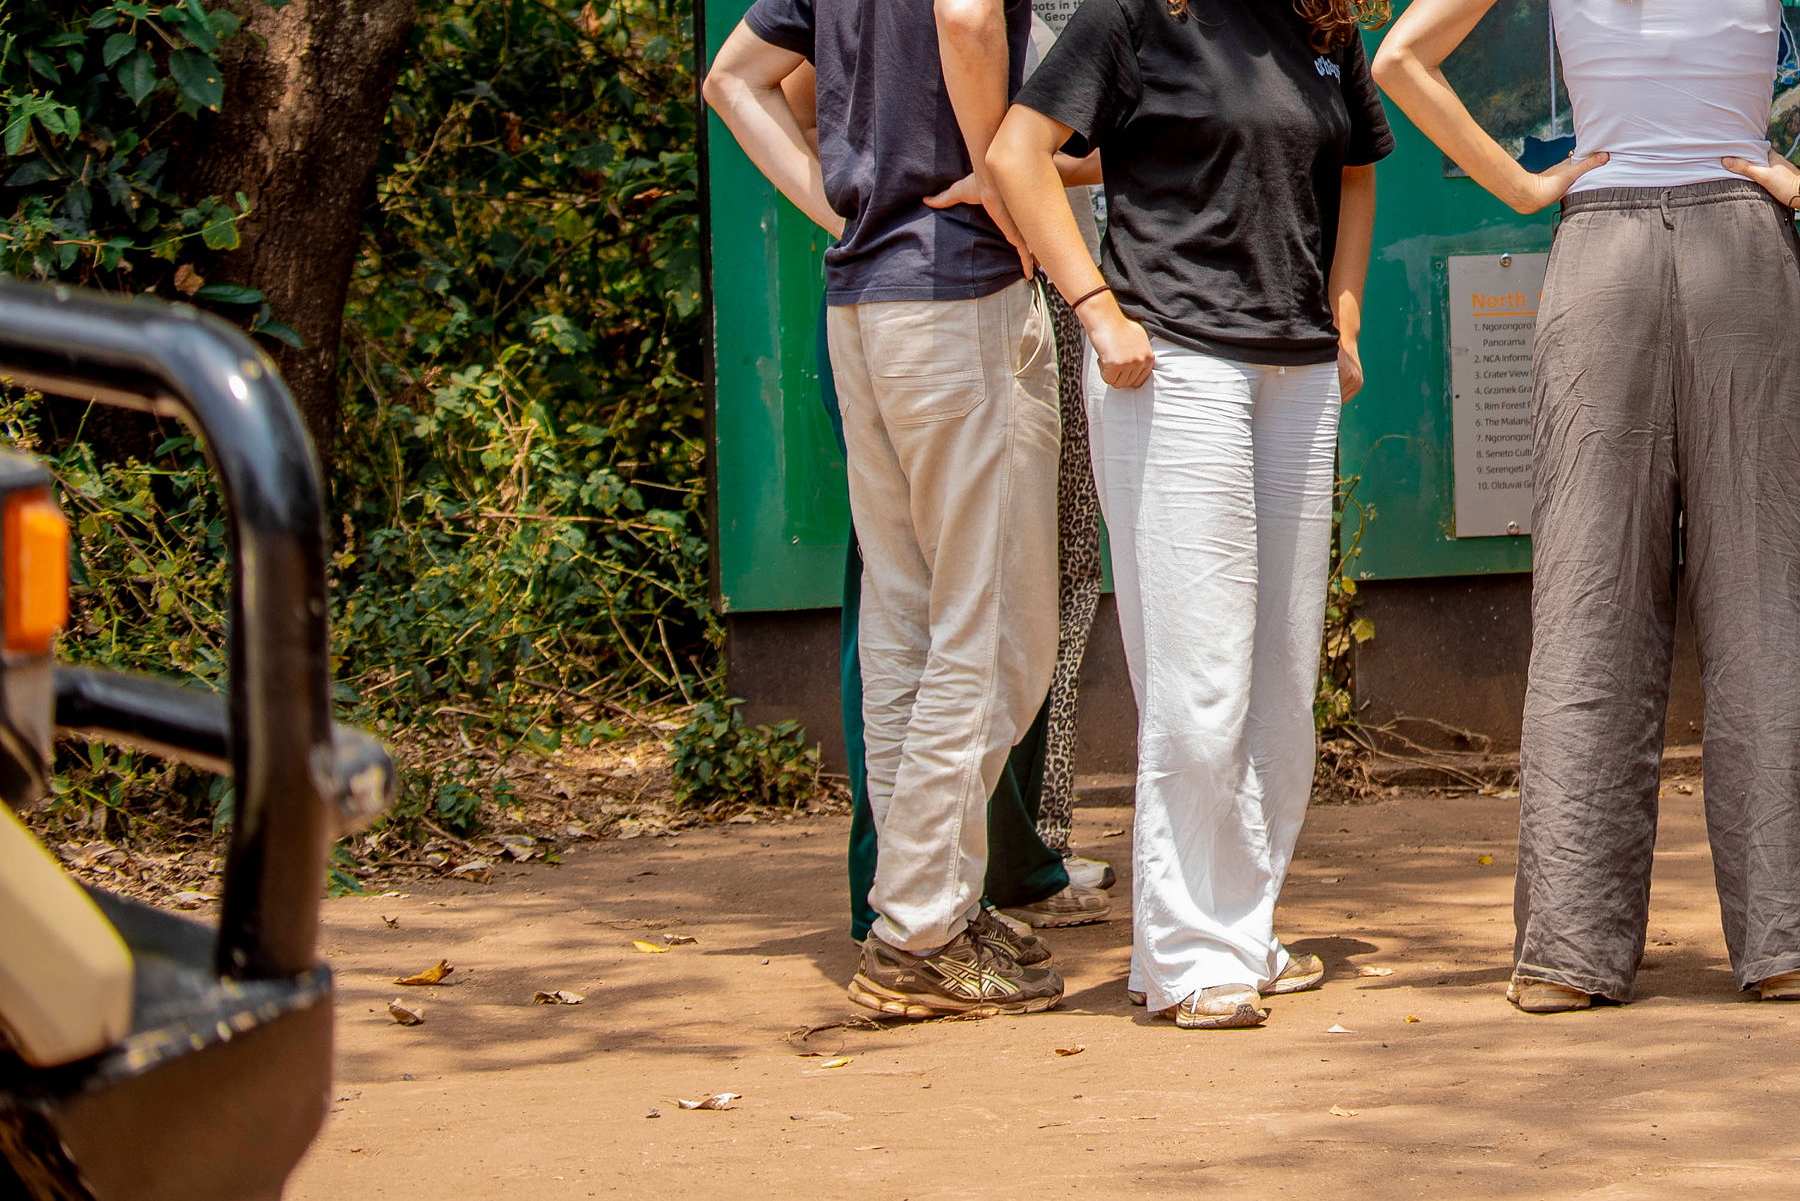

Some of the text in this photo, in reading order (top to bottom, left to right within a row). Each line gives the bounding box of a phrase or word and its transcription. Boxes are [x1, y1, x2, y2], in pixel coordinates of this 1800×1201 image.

[1059, 1, 1070, 10] in
[1471, 289, 1527, 310] North
[1482, 322, 1532, 333] Ngorongoro
[1483, 339, 1526, 347] Panorama
[1474, 355, 1481, 364] 2.
[1502, 353, 1533, 362] Informa
[1474, 371, 1480, 379] 3.
[1483, 370, 1507, 378] Crater
[1509, 369, 1528, 377] View
[1474, 385, 1516, 395] 4. Grzimek
[1475, 403, 1482, 411] 5.
[1484, 402, 1500, 410] Rim
[1501, 401, 1526, 410] Forest
[1475, 419, 1482, 427] 6.
[1485, 418, 1499, 426] The
[1476, 435, 1483, 443] 7.
[1476, 449, 1513, 458] 8. Seneto
[1486, 465, 1524, 475] Serengeti
[1478, 482, 1489, 491] 10.
[1491, 481, 1522, 490] Olduvai
